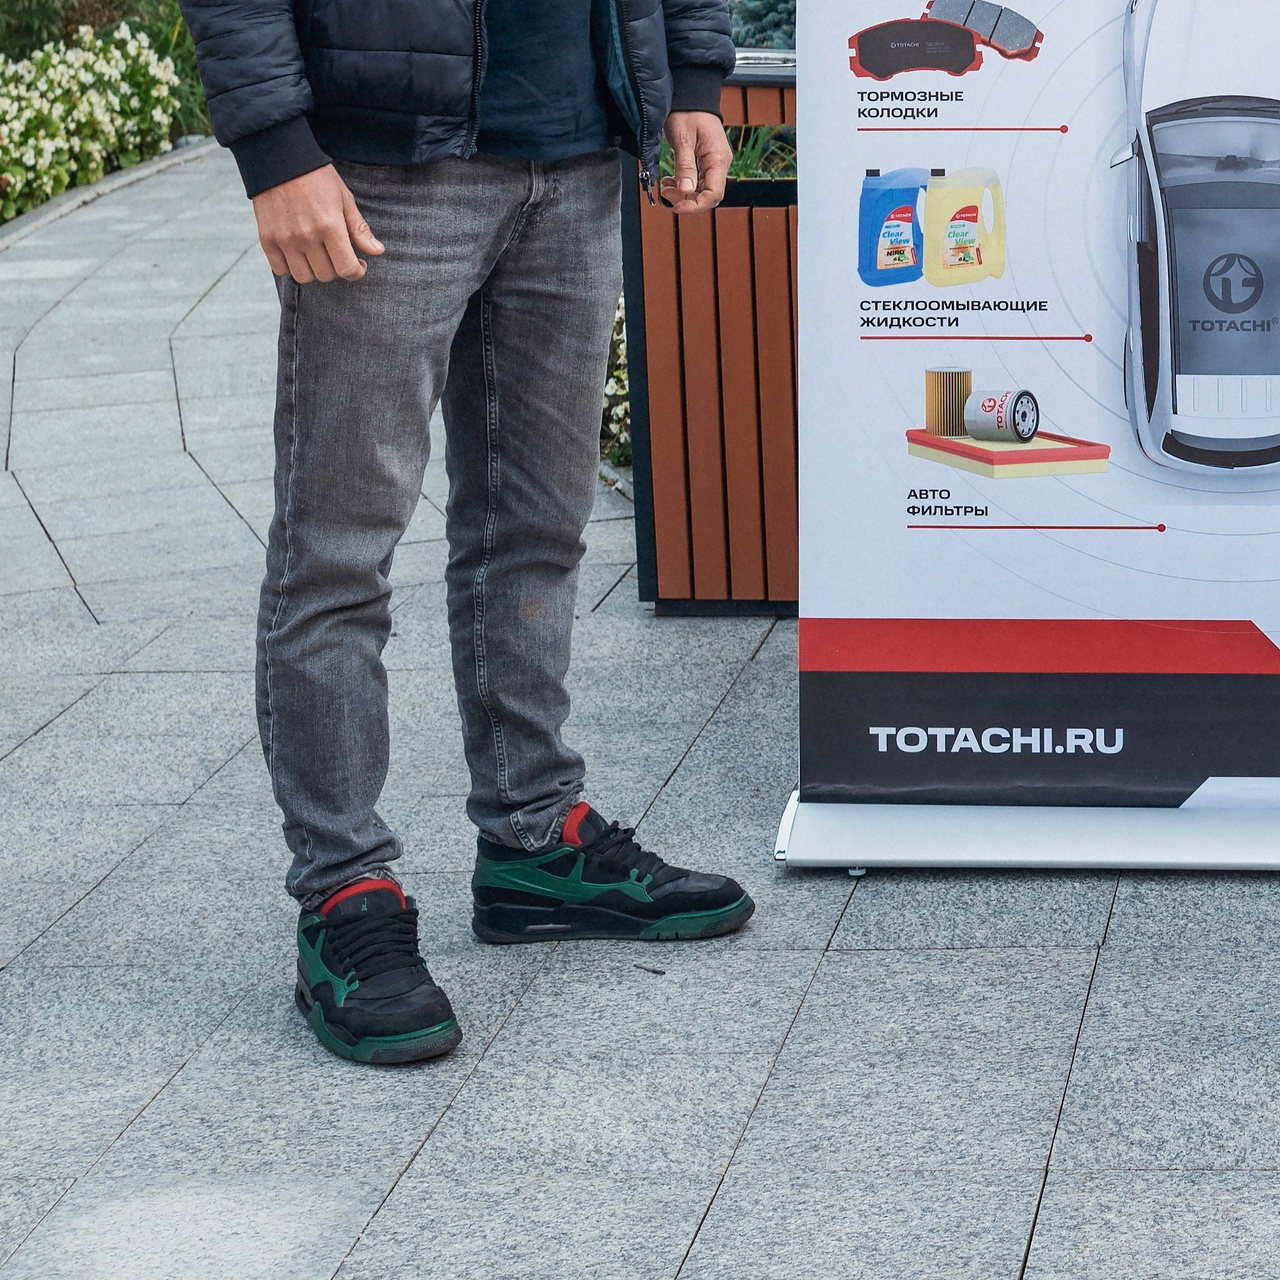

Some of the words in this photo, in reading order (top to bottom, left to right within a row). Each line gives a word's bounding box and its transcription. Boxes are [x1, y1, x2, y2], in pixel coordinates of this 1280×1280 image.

[857, 90, 964, 102] ТОРМОЗНЫЕ
[857, 107, 939, 120] КОЛОДКИ
[882, 231, 904, 239] Clear
[947, 231, 969, 239] Clear
[889, 238, 911, 246] View
[954, 238, 976, 246] View
[859, 300, 1049, 314] СТЕКЛООМЫВАЮЩИЕ
[859, 316, 959, 329] ЖИДКОСТИ
[907, 489, 951, 500] АВТО
[906, 505, 989, 517] ФИЛЬТРЫ
[868, 726, 1125, 755] TOTACHI.RU
